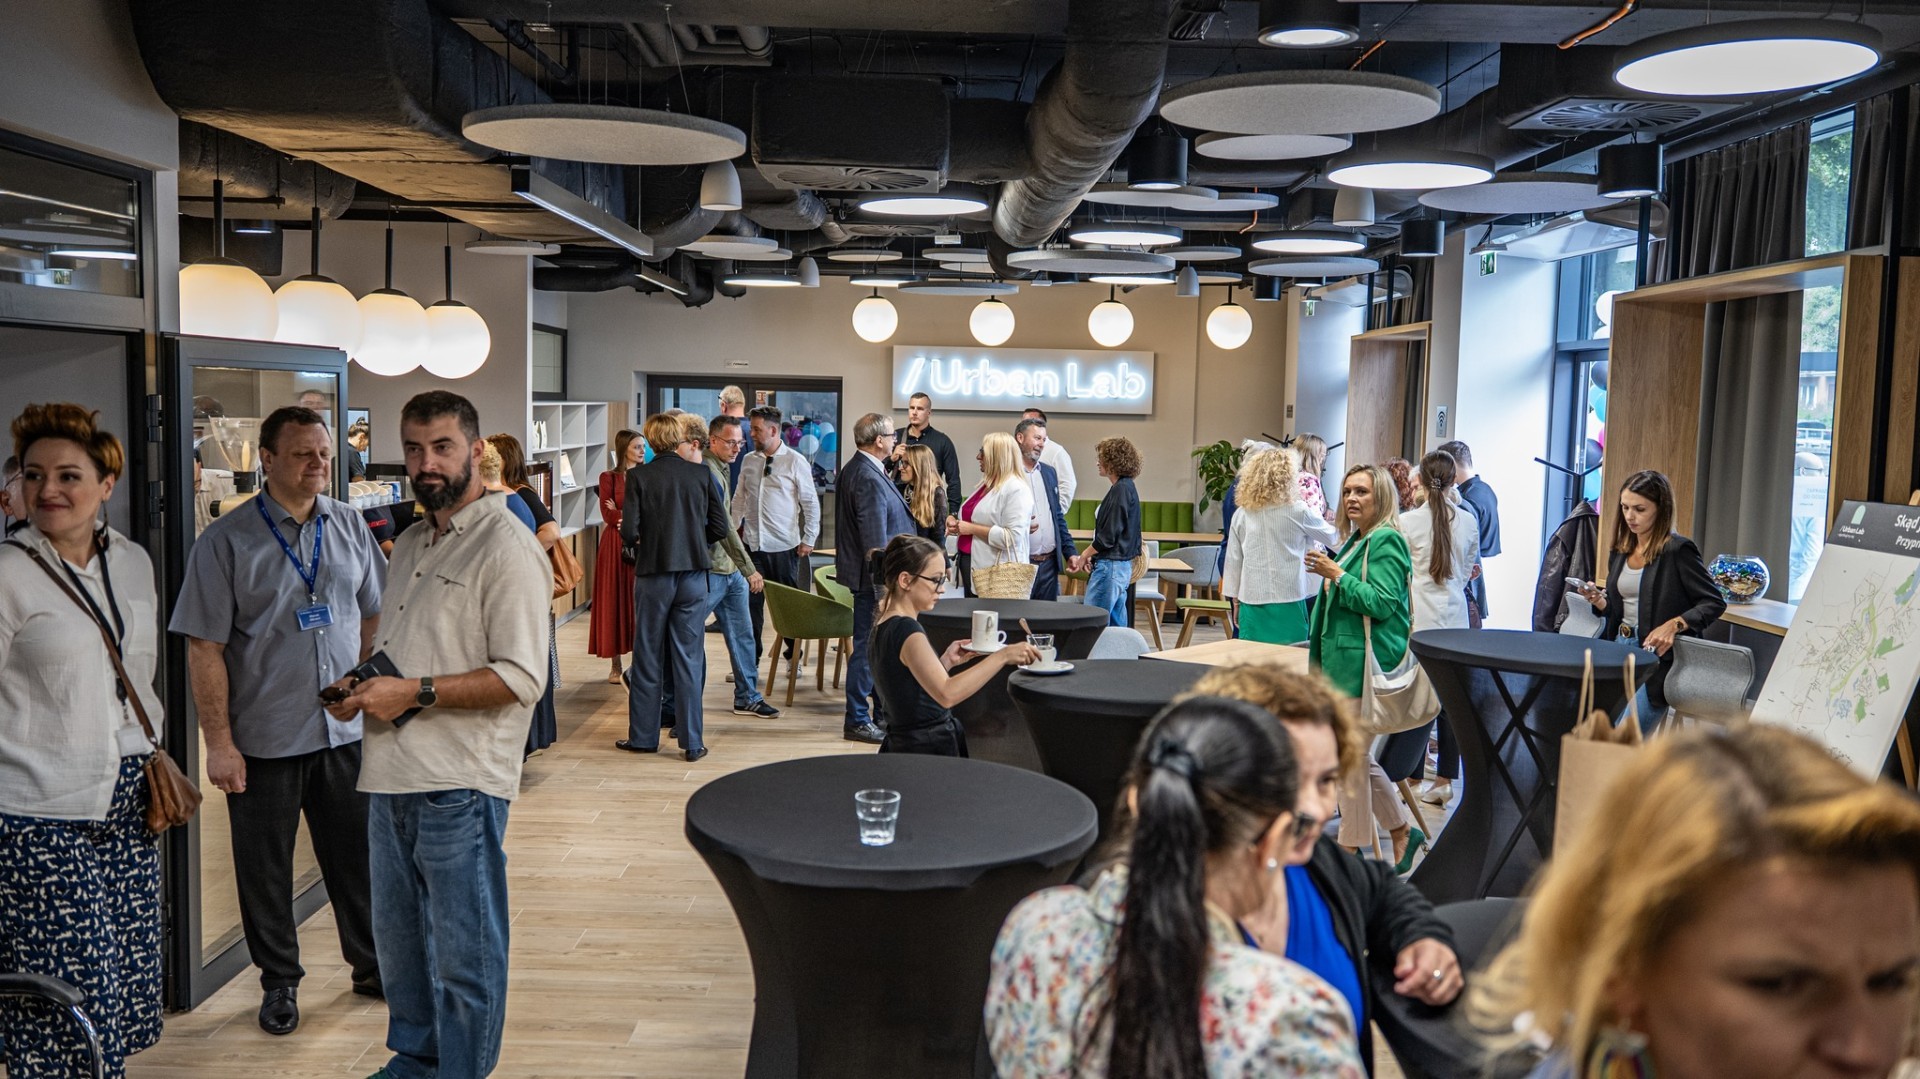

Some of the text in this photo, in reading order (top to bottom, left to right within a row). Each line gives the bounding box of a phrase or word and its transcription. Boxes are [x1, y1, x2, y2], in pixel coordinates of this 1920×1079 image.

[1067, 362, 1147, 399] Lab
[1855, 527, 1865, 535] Lab
[1894, 514, 1920, 532] Skąd
